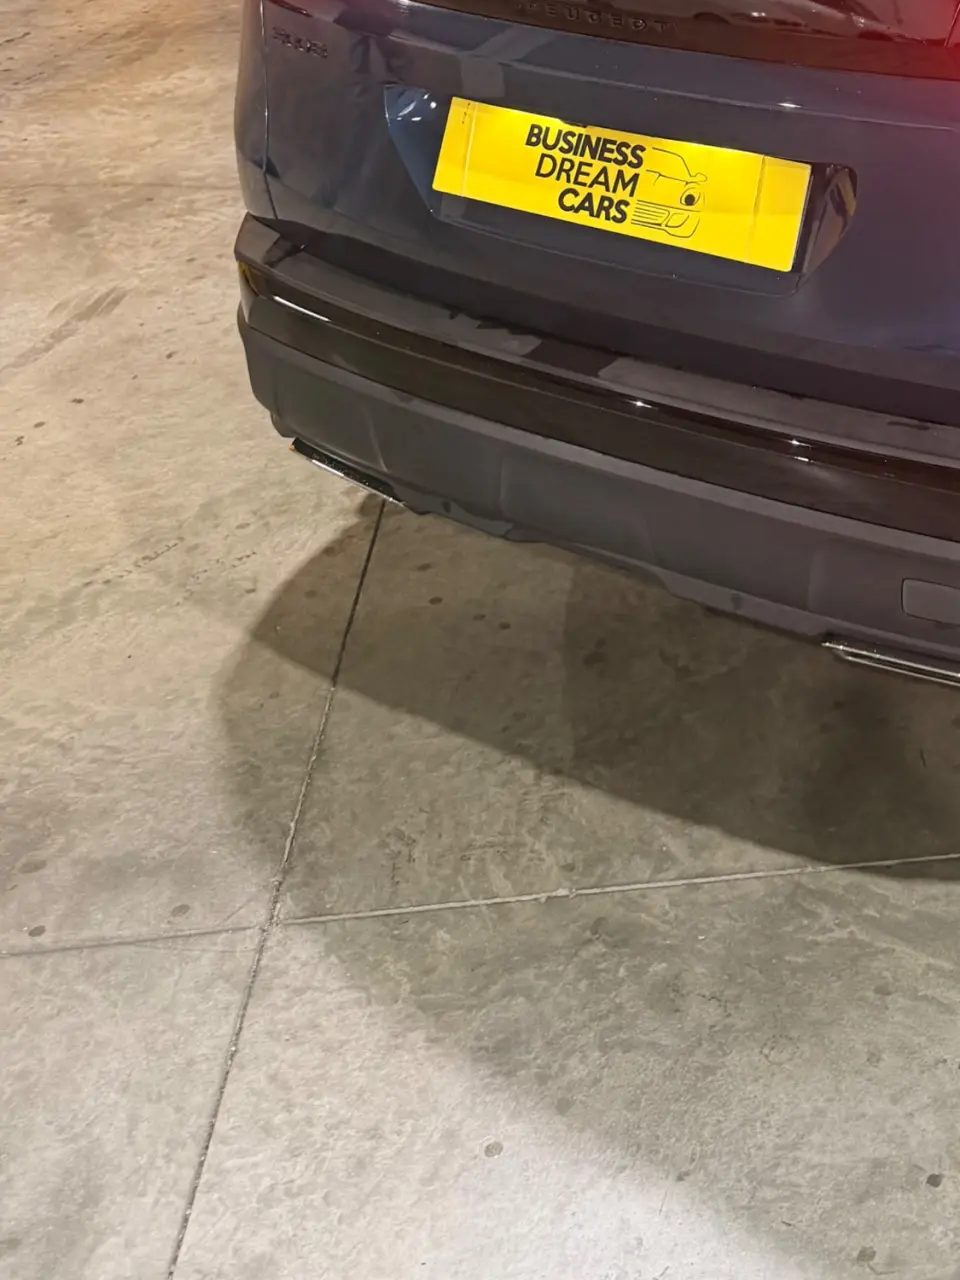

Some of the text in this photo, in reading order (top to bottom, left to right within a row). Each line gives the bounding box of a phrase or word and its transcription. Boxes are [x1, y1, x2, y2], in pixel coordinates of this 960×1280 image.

[525, 123, 646, 169] BUSINESS
[534, 152, 640, 198] DREAM
[557, 187, 630, 224] CARS
